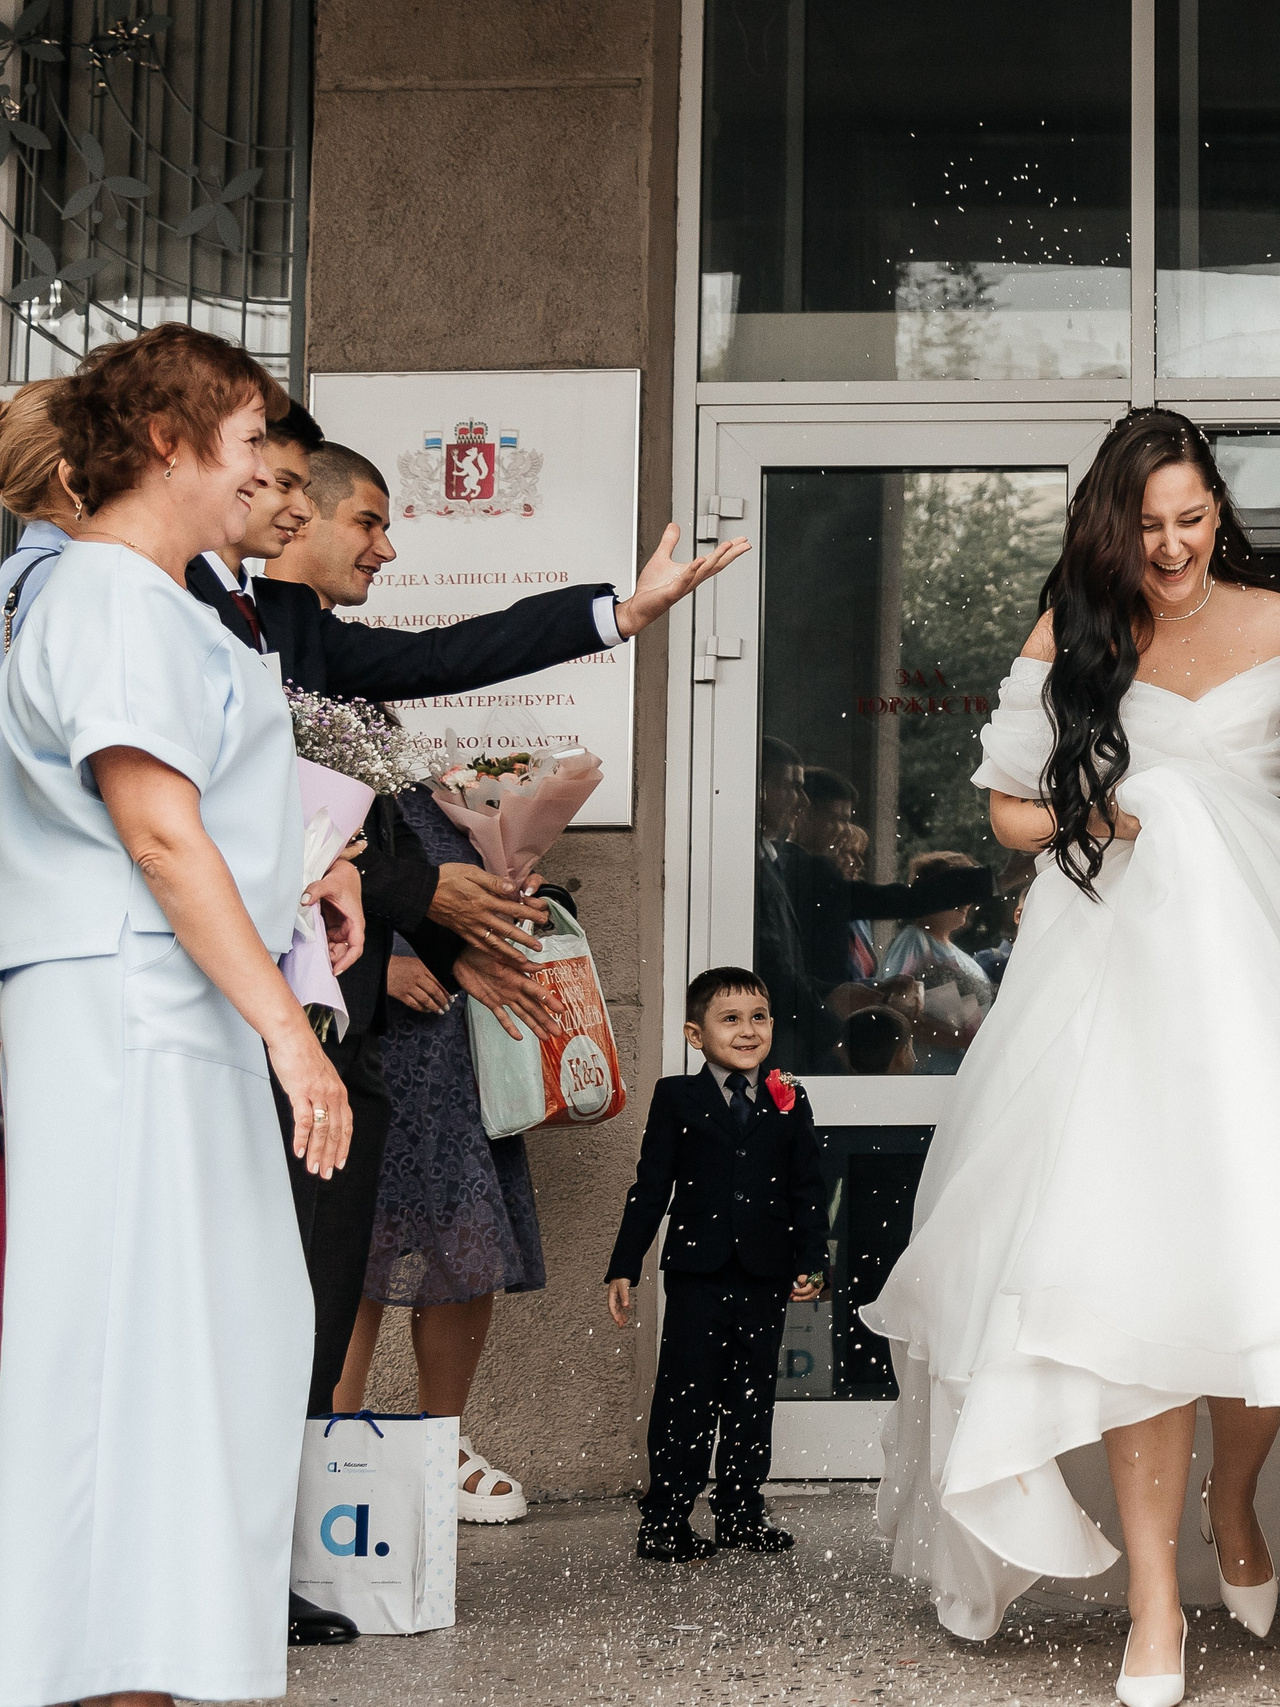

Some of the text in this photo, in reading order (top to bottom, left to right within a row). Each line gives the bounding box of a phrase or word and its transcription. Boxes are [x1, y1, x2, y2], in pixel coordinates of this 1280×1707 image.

[372, 571, 569, 587] ОТДЕЛ ЗАПИСИ АКТОВ
[895, 668, 947, 687] ЗАЛ
[855, 695, 989, 715] ТОРЖЕСТВ
